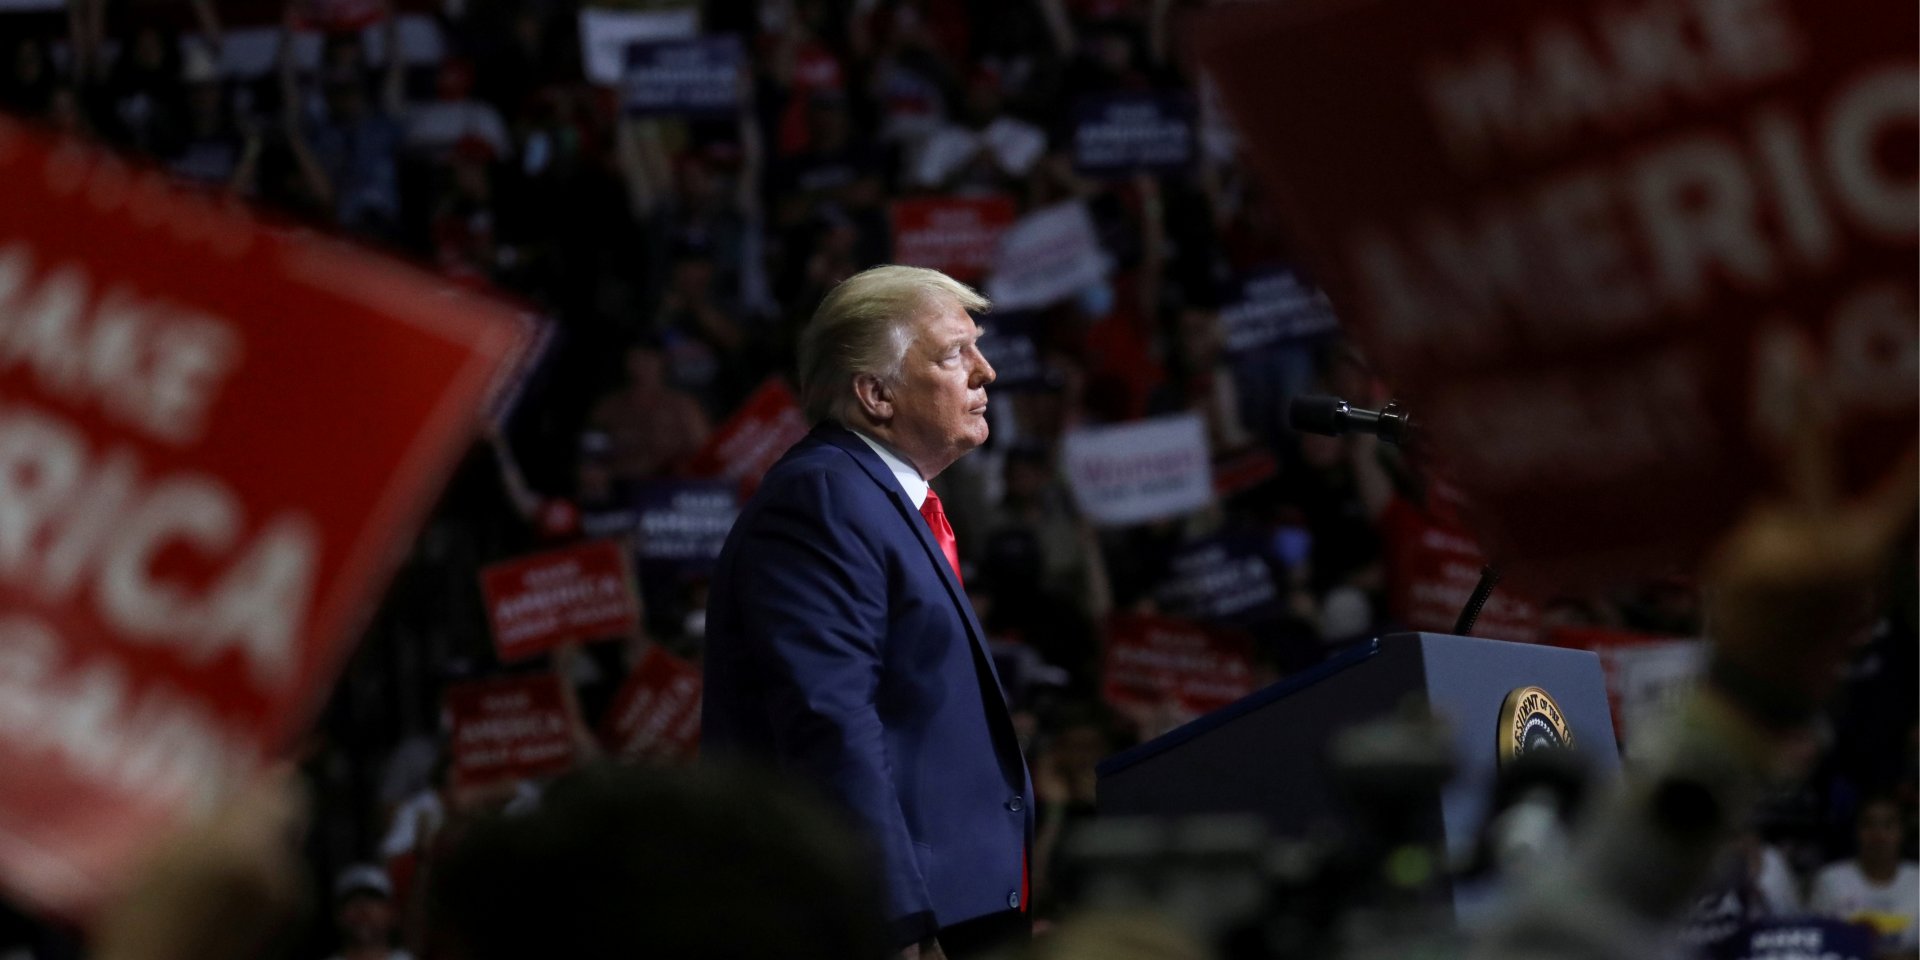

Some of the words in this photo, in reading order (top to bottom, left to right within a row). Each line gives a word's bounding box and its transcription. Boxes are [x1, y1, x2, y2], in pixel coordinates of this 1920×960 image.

[1514, 694, 1539, 756] RESIDENT
[1540, 698, 1548, 711] OF
[1548, 704, 1560, 727] THE
